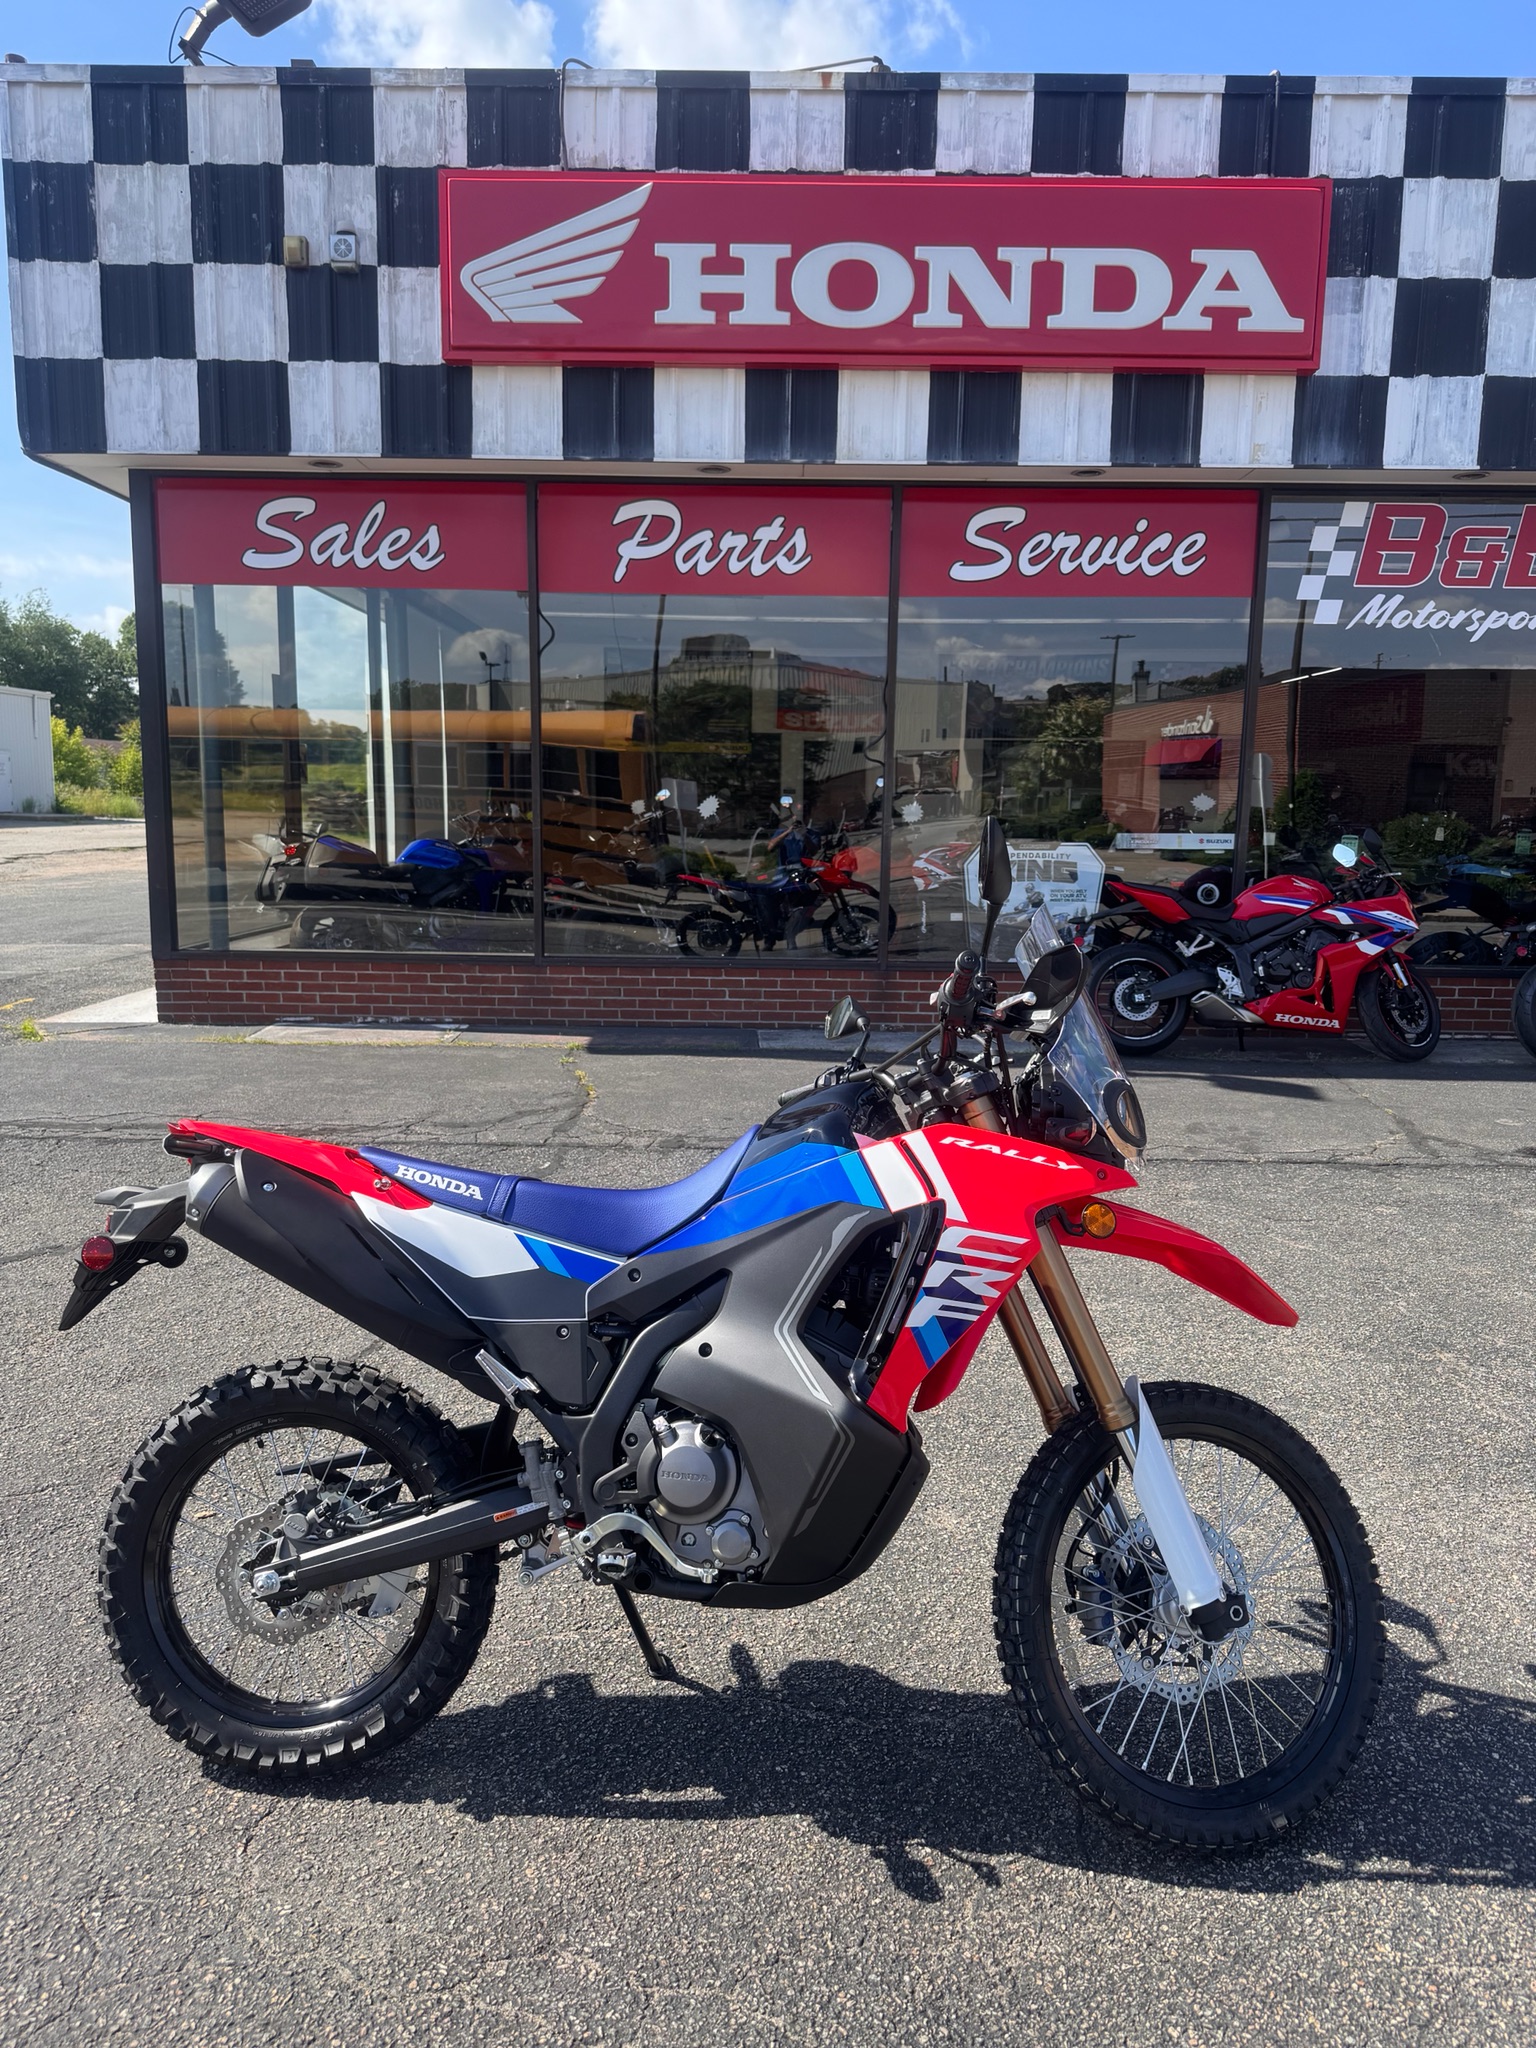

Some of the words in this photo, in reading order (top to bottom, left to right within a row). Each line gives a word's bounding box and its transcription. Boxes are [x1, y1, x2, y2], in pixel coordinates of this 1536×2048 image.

[654, 241, 1305, 333] HONDA
[241, 495, 446, 571] Sales
[611, 499, 813, 583] Parts
[948, 505, 1207, 582] Service
[1010, 852, 1072, 860] PENDABILITY
[1274, 1013, 1340, 1028] HONDA
[939, 1136, 1084, 1170] RALLY
[394, 1164, 483, 1200] HONDA
[661, 1470, 712, 1483] HONDA
